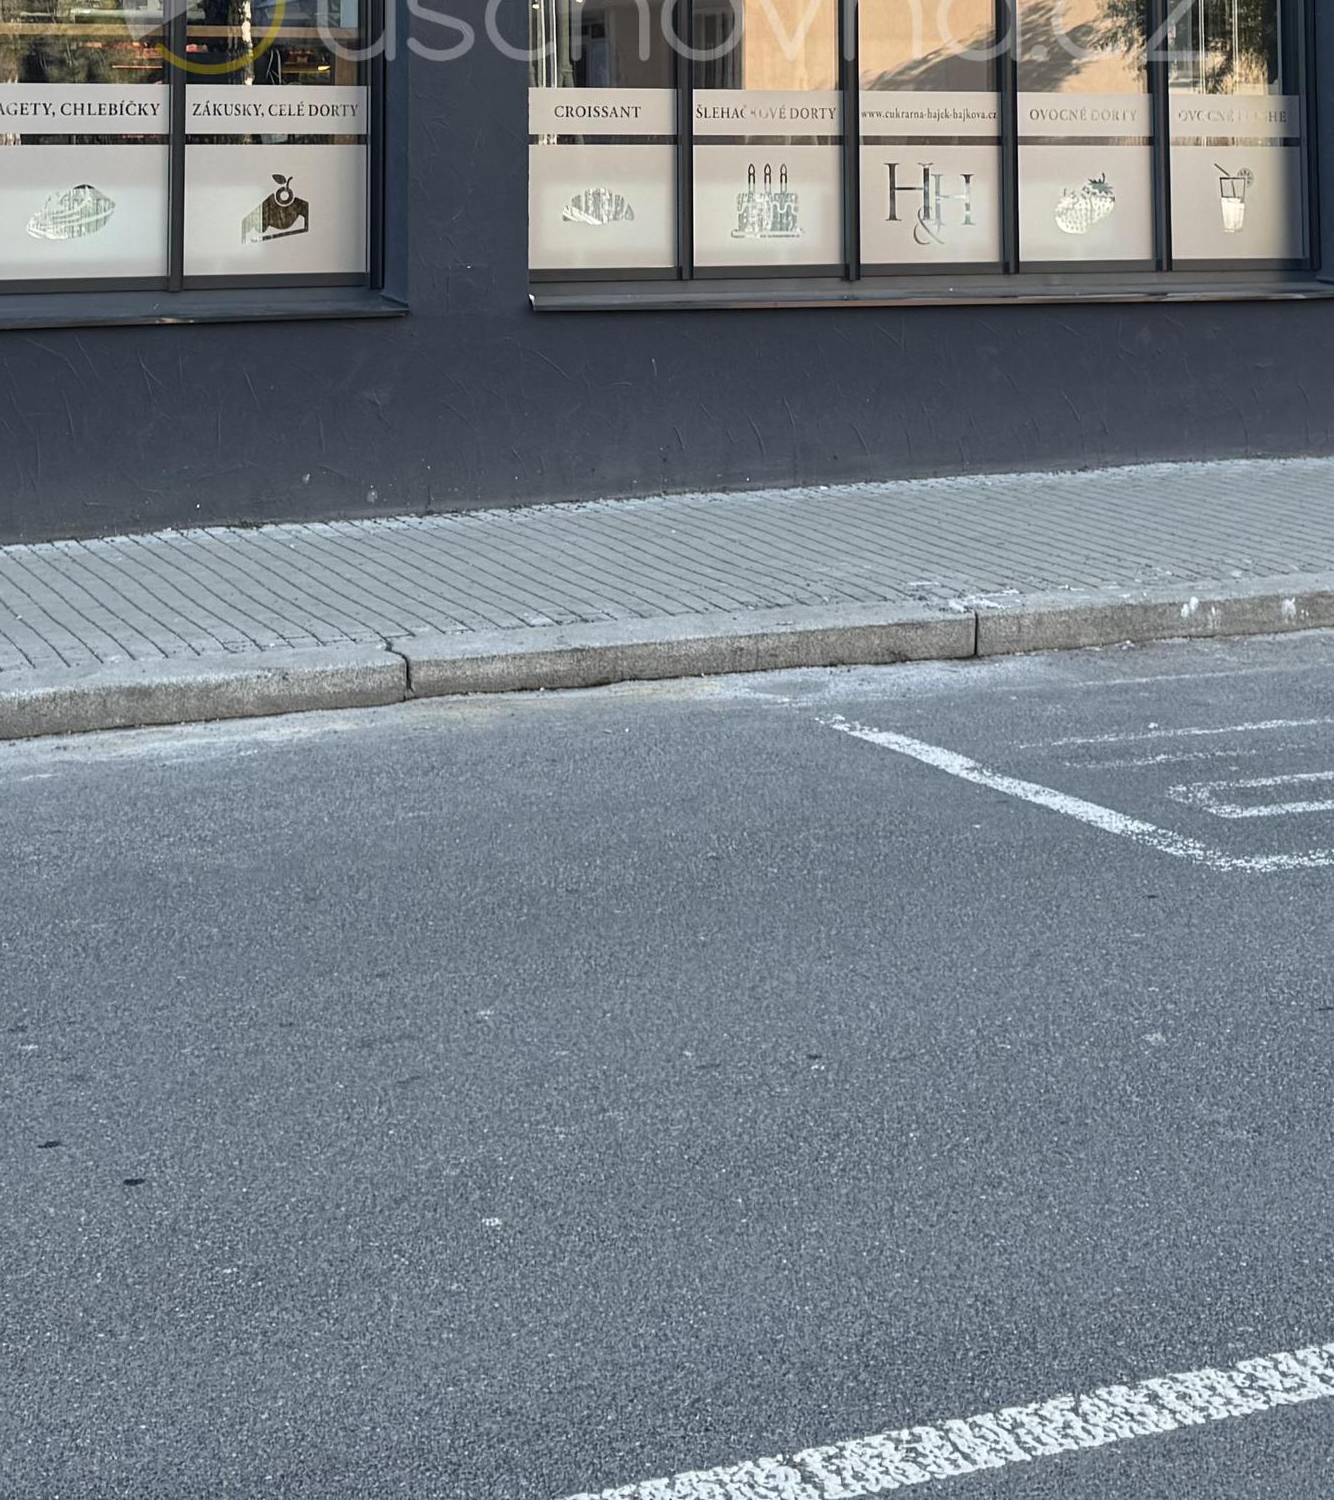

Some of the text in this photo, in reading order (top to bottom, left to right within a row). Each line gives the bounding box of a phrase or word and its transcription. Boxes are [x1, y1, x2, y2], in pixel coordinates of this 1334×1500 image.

[60, 100, 160, 116] CHLEBÍČKY
[192, 100, 358, 118] ZÁKUSKY, CELÉ DORTY
[554, 106, 641, 118] CROISSANT
[789, 107, 836, 119] DORTY
[1029, 106, 1087, 121] OVOCNÉ
